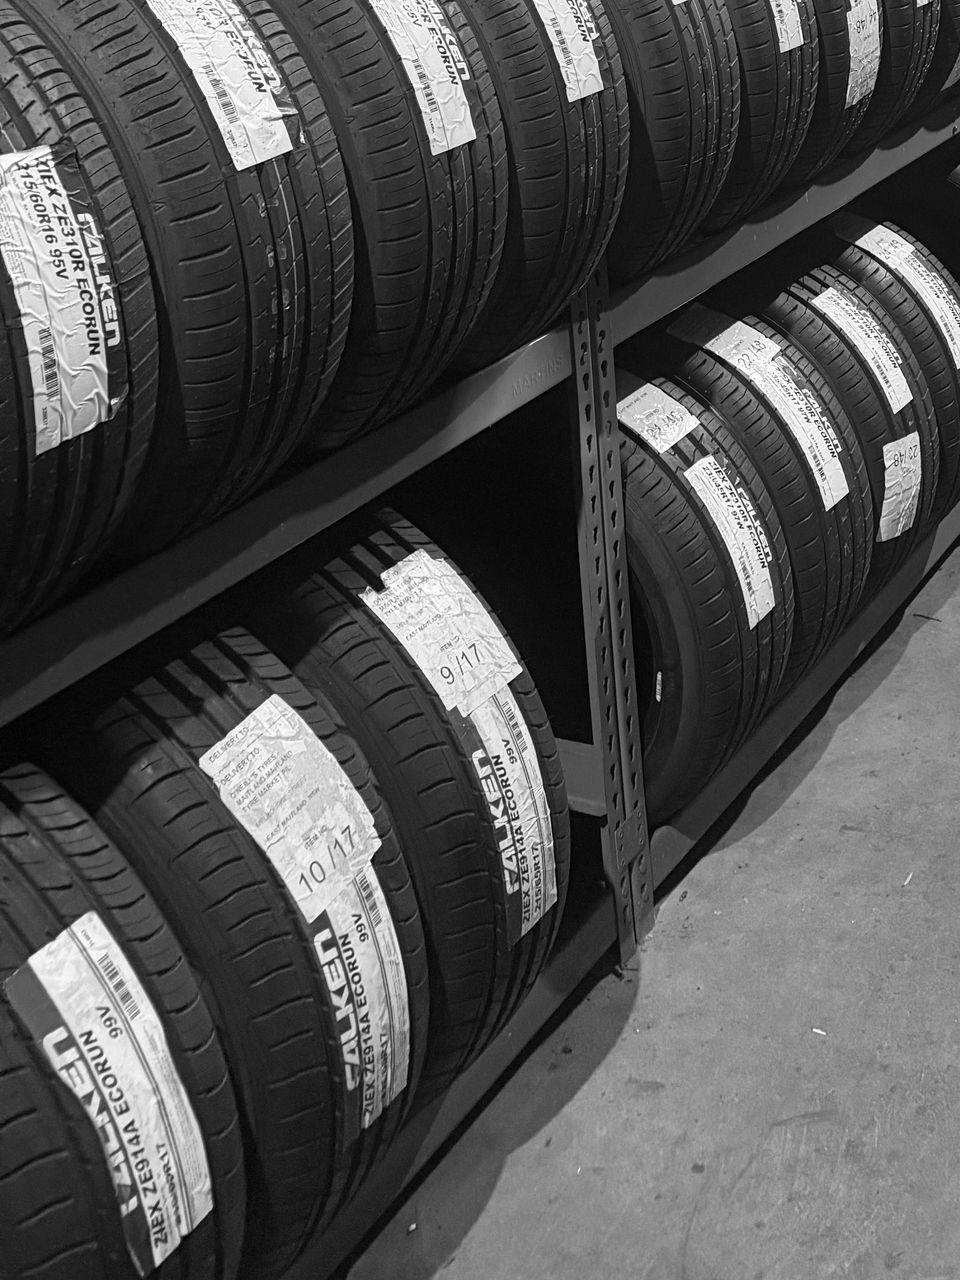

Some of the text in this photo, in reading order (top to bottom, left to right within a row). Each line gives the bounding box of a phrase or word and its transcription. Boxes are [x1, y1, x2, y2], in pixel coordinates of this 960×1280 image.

[16, 161, 70, 281] 215/60R16 95V
[53, 202, 85, 273] ZE310R
[75, 277, 101, 356] ECORUN
[77, 212, 121, 348] FALKEN
[873, 332, 899, 370] ECORUN
[814, 419, 838, 459] ECORUN
[747, 524, 768, 570] ECORUN
[501, 738, 518, 765] 99V
[472, 748, 520, 895] FALKEN
[491, 754, 532, 923] ZIEX ZE914A ECORUN
[351, 913, 370, 943] 99V
[95, 1004, 125, 1041] 99V
[314, 927, 362, 1092] FALKEN
[339, 933, 376, 1117] ZIEX ZE914A ECORUN
[42, 1024, 140, 1219] FALKEN
[78, 1029, 170, 1250] ZIEX ZE914A ECORUN
